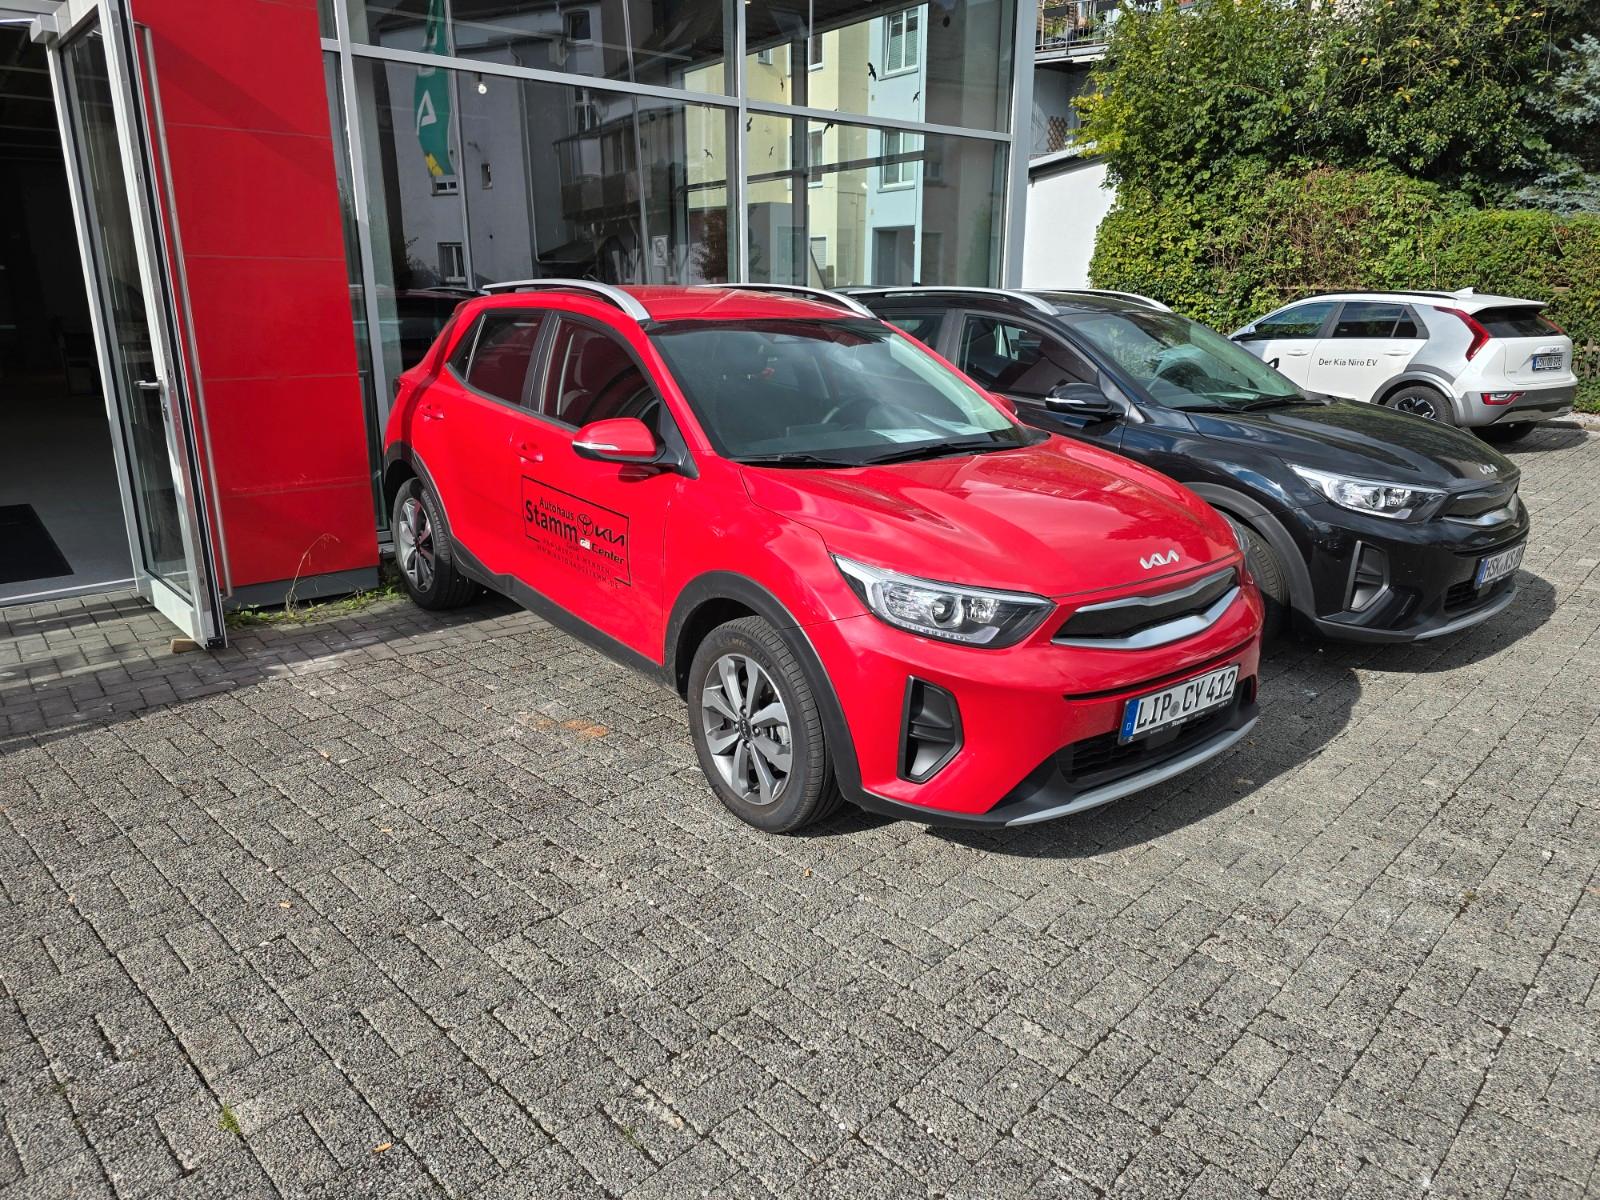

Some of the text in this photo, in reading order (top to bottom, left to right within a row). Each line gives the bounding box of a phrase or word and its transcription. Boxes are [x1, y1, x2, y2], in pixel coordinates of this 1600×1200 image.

[1318, 358, 1378, 367] Der Kia Niro EV
[539, 496, 574, 521] Autohaus
[525, 499, 579, 544] Stamm
[591, 542, 625, 566] Center
[1139, 549, 1180, 570] KIA
[1136, 669, 1236, 730] LIP CY 412
